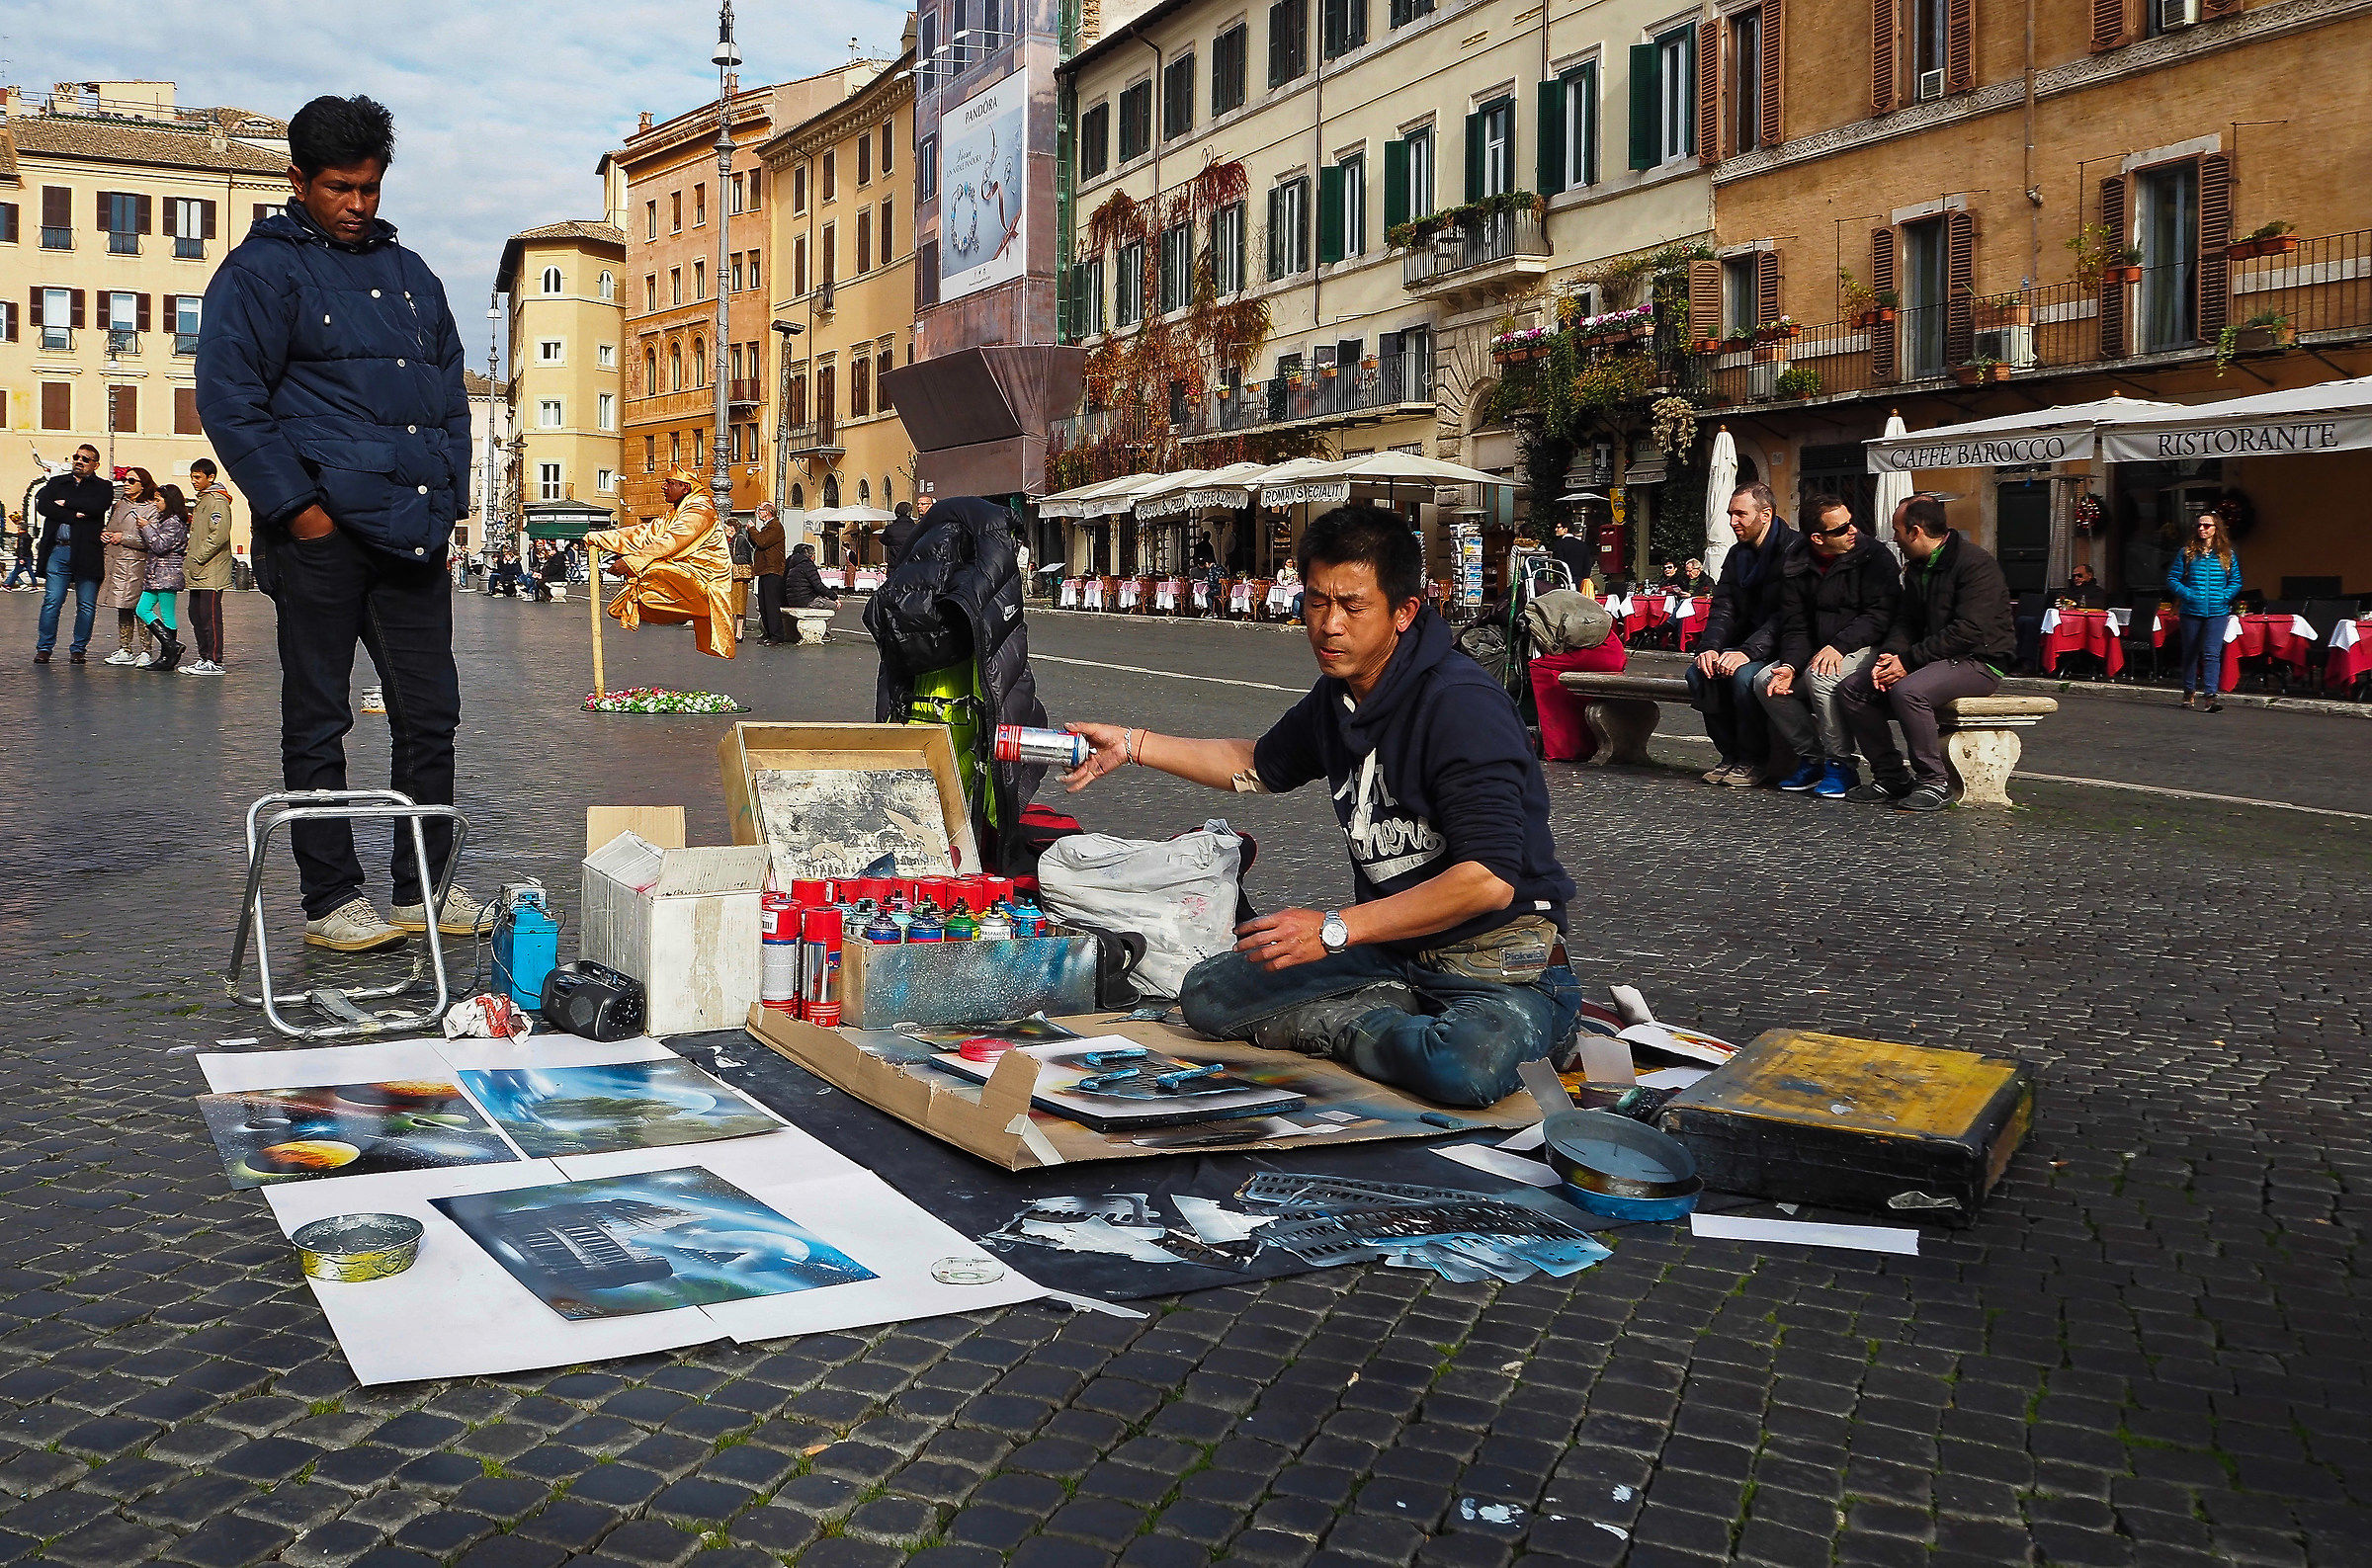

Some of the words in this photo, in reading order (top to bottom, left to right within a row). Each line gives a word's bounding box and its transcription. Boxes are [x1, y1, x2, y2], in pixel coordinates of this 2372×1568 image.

[965, 96, 998, 124] PANDORA
[1891, 442, 1952, 468] CAFFÈ
[1957, 437, 2066, 464] BAROCCO
[2158, 423, 2338, 456] RISTORANTE
[1265, 487, 1295, 503] ROMAN
